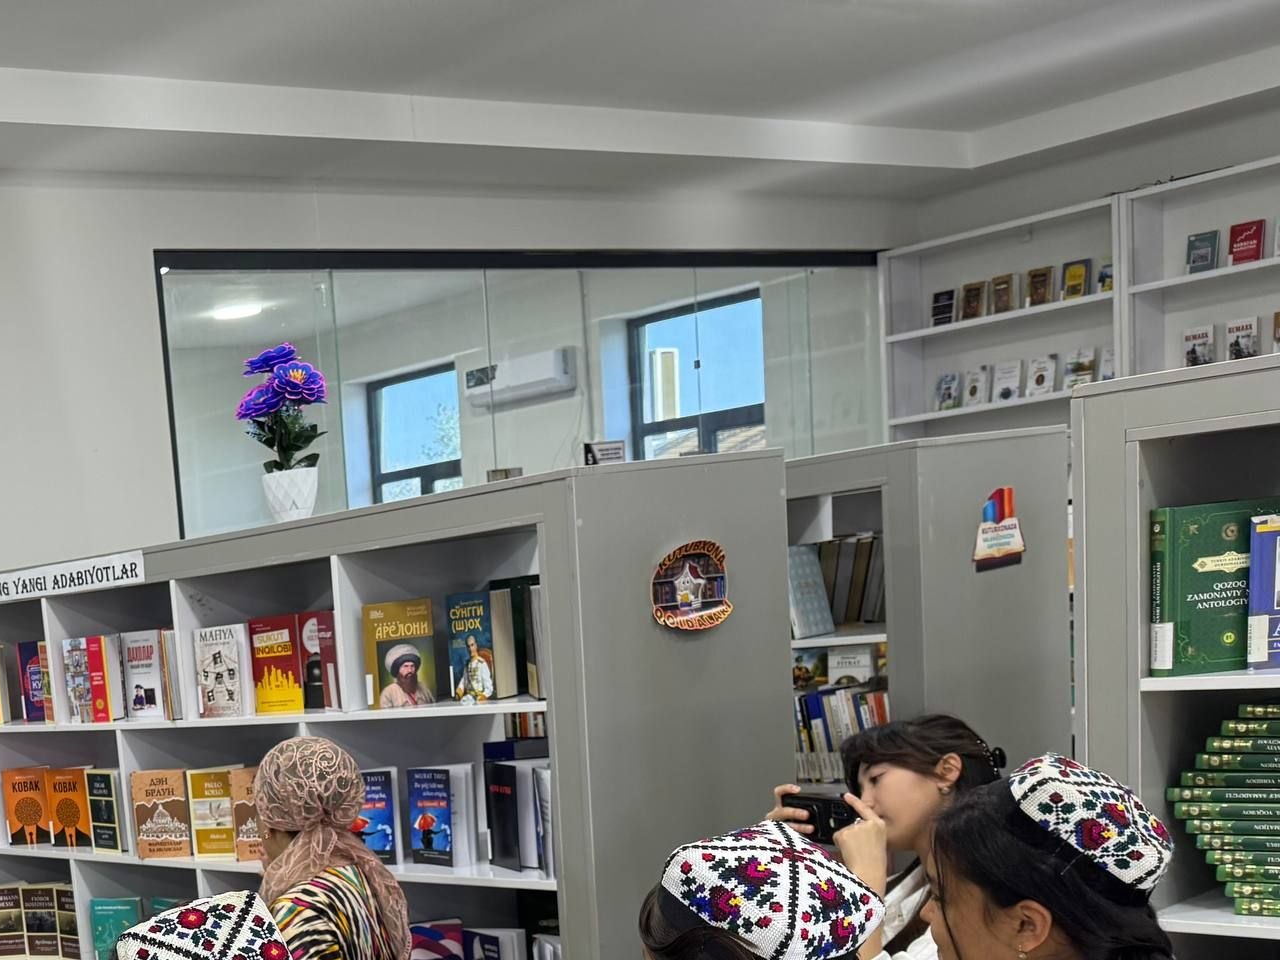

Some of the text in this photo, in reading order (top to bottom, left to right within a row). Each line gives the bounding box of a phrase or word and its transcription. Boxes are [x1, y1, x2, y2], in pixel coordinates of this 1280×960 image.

[658, 540, 726, 572] KUTUBXONA
[13, 575, 47, 595] YANGI
[52, 562, 138, 590] ADABIYOTLAR
[1213, 580, 1247, 591] QOZOQ
[1186, 590, 1242, 602] ZAMONAVIY
[1196, 598, 1249, 609] ANTOLOGIY
[199, 628, 234, 643] MAFIYA
[255, 643, 291, 656] INQILOBI
[150, 777, 168, 787] ДЭН
[145, 788, 175, 798] БРАУН
